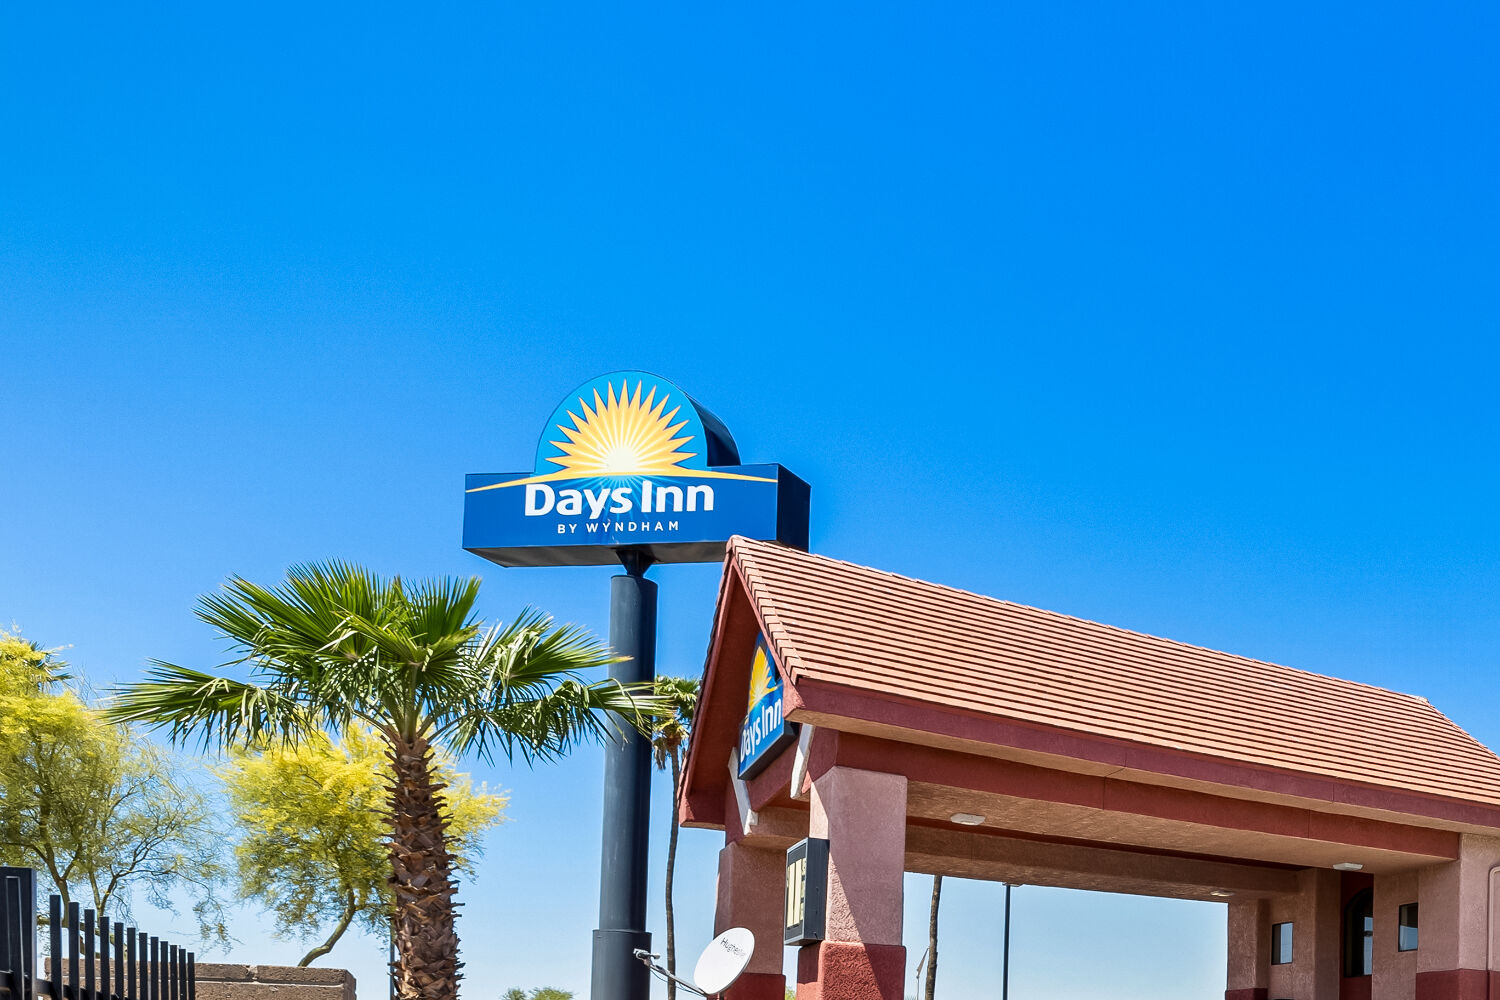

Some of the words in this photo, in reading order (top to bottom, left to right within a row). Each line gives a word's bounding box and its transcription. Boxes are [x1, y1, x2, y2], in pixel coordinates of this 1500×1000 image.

[525, 483, 633, 520] Days
[641, 480, 715, 513] Inn
[557, 523, 578, 534] BY
[586, 520, 679, 533] WYNDHAM
[740, 717, 761, 764] Days
[762, 698, 782, 739] Inn
